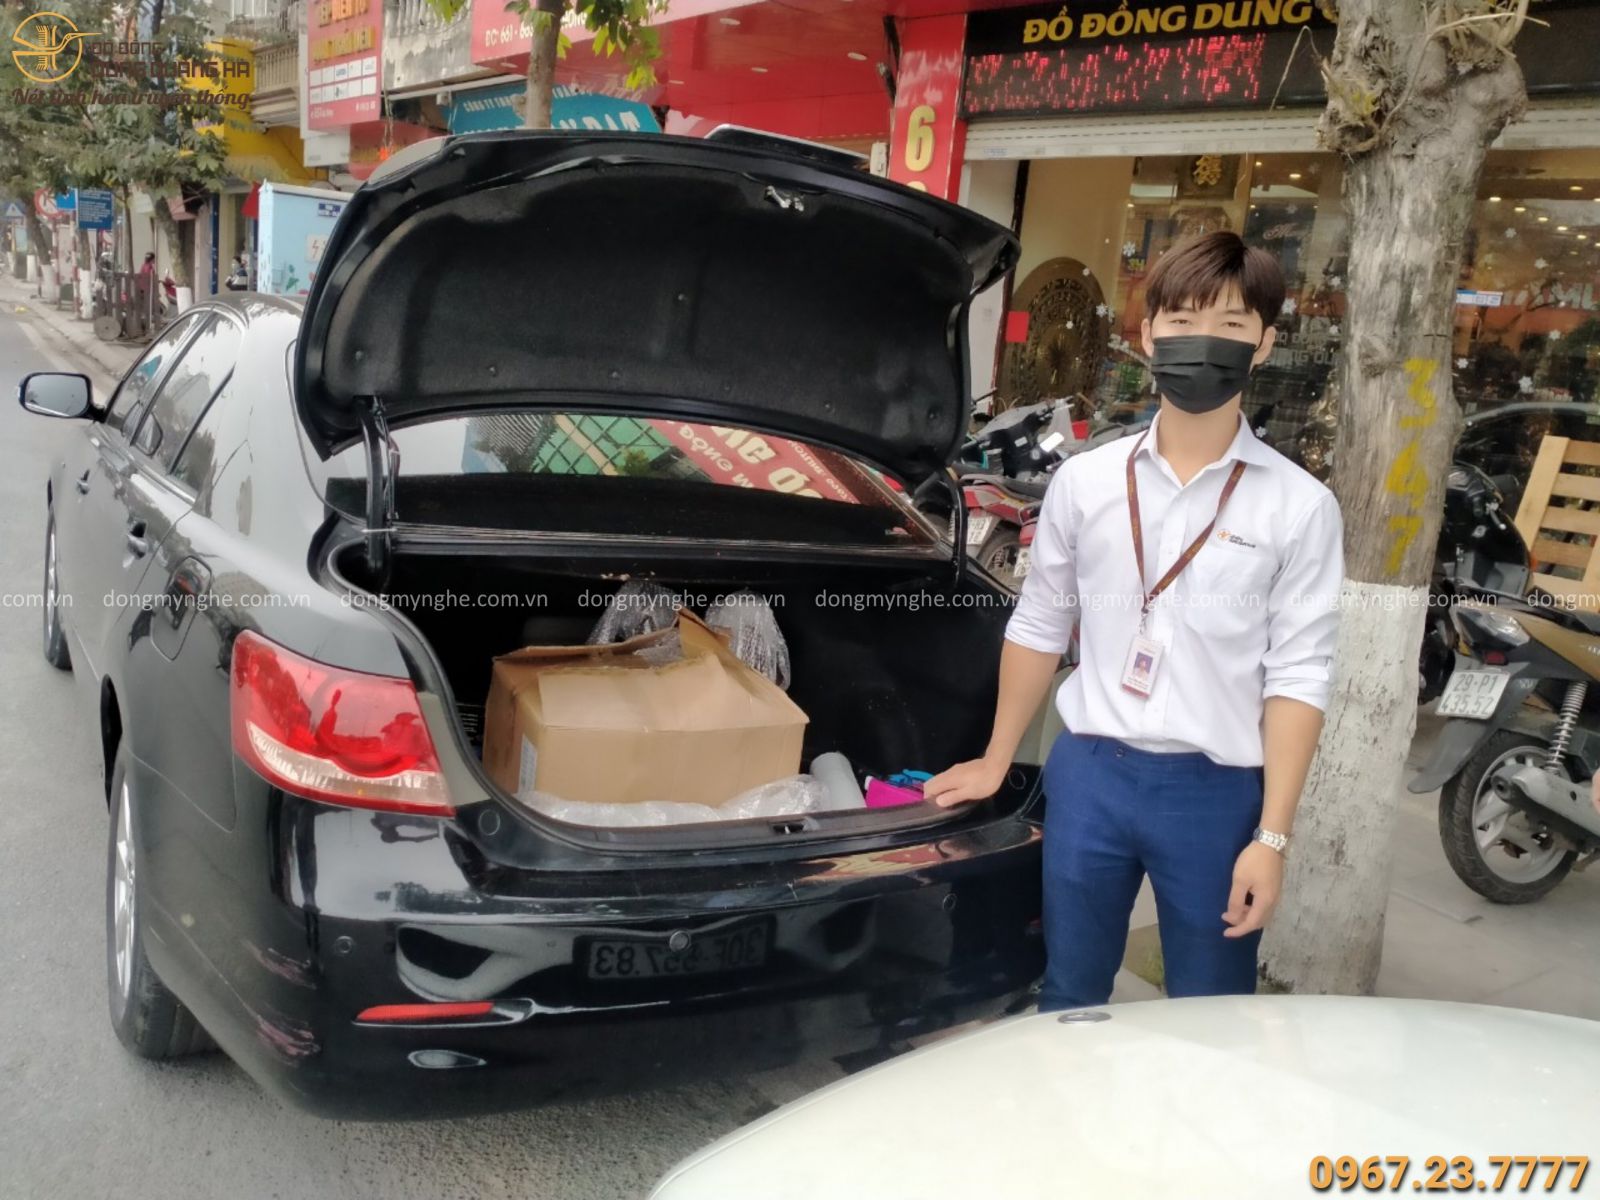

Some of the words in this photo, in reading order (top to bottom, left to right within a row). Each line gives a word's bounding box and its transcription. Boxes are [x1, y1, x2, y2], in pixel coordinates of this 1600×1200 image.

[1023, 5, 1073, 43] ĐỒ
[1080, 0, 1187, 38] ĐỒNG
[1193, 0, 1313, 29] DUNG
